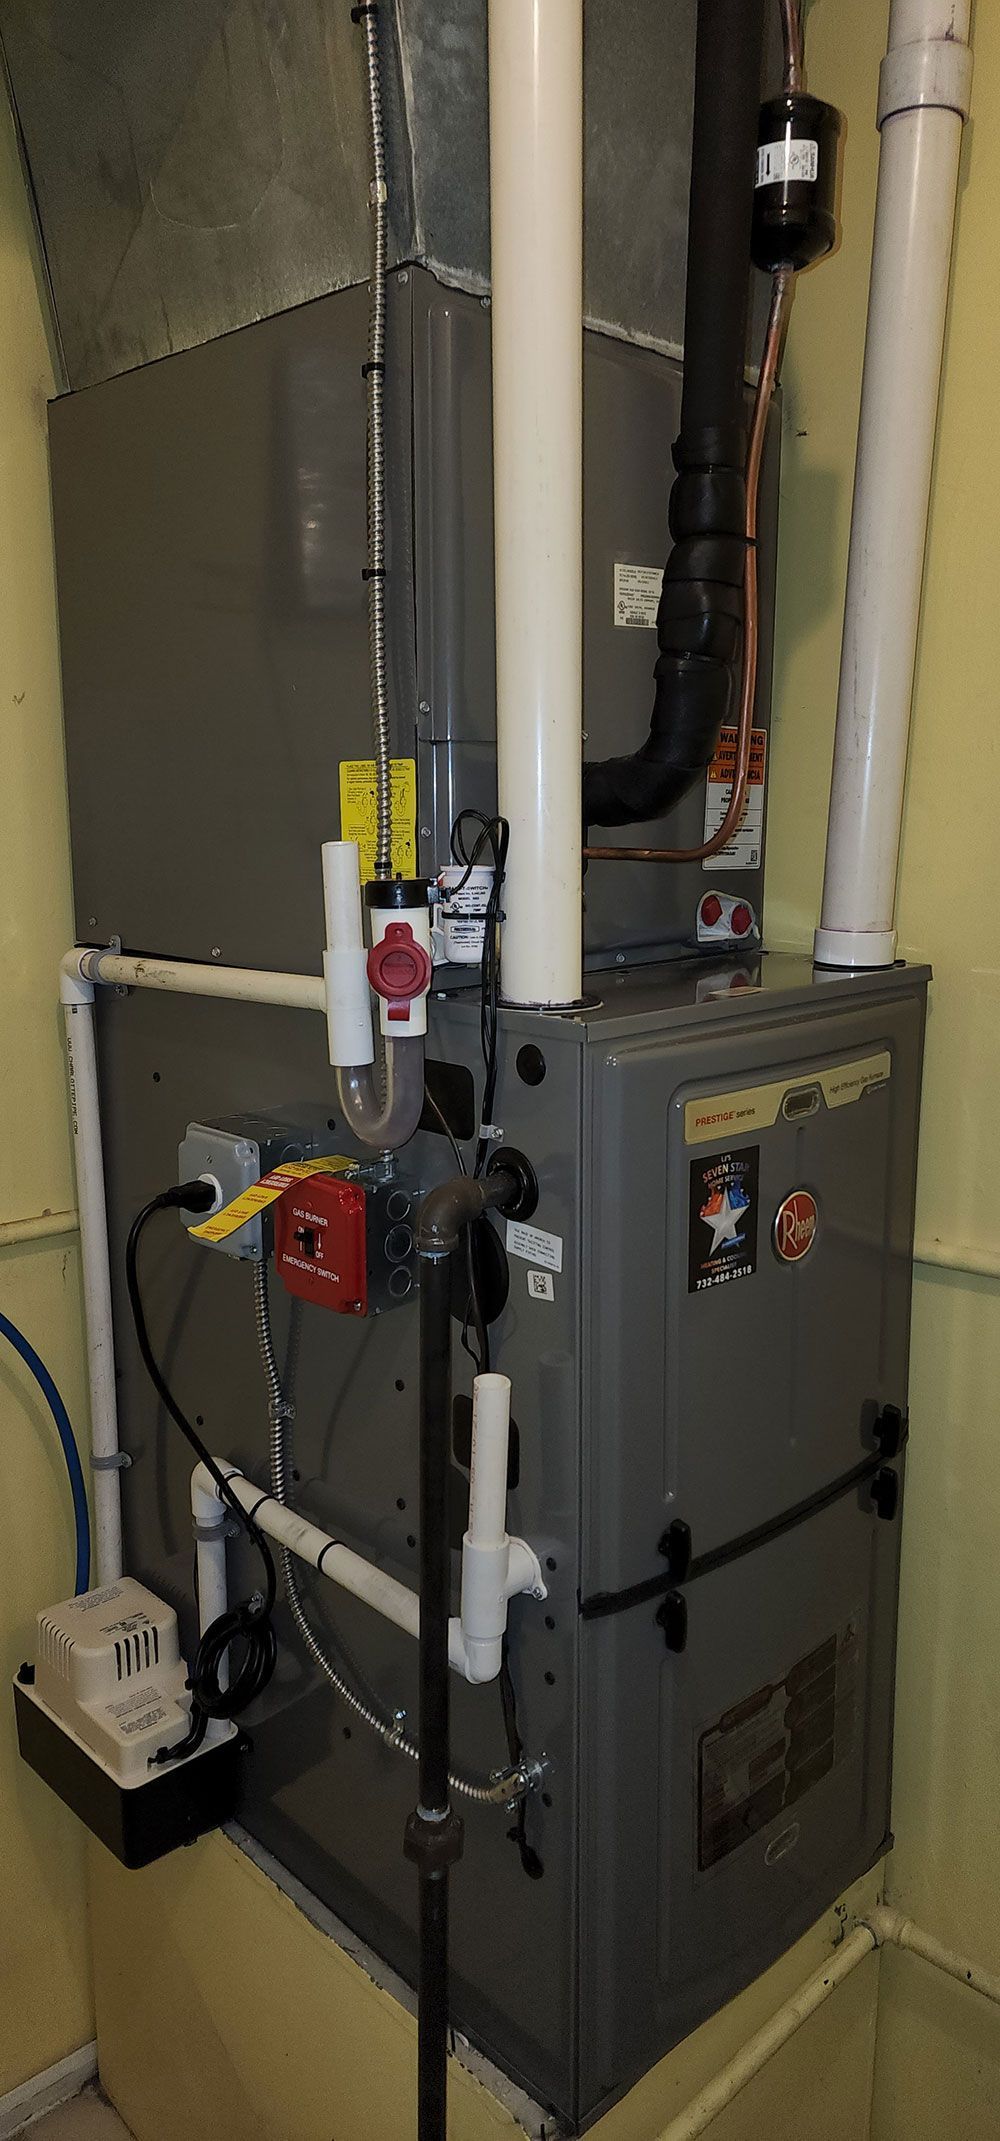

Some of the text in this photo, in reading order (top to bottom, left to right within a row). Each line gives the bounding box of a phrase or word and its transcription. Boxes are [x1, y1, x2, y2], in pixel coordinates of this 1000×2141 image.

[720, 732, 764, 746] WANG
[702, 1161, 751, 1184] SEVEN STAR
[292, 1207, 328, 1227] GAS BURNER
[782, 1199, 815, 1251] Rheem
[297, 1225, 305, 1233] ON
[315, 1250, 324, 1260] OFF
[282, 1253, 340, 1283] EMERGENCY SWITCH
[696, 1264, 753, 1290] 732-484-2518
